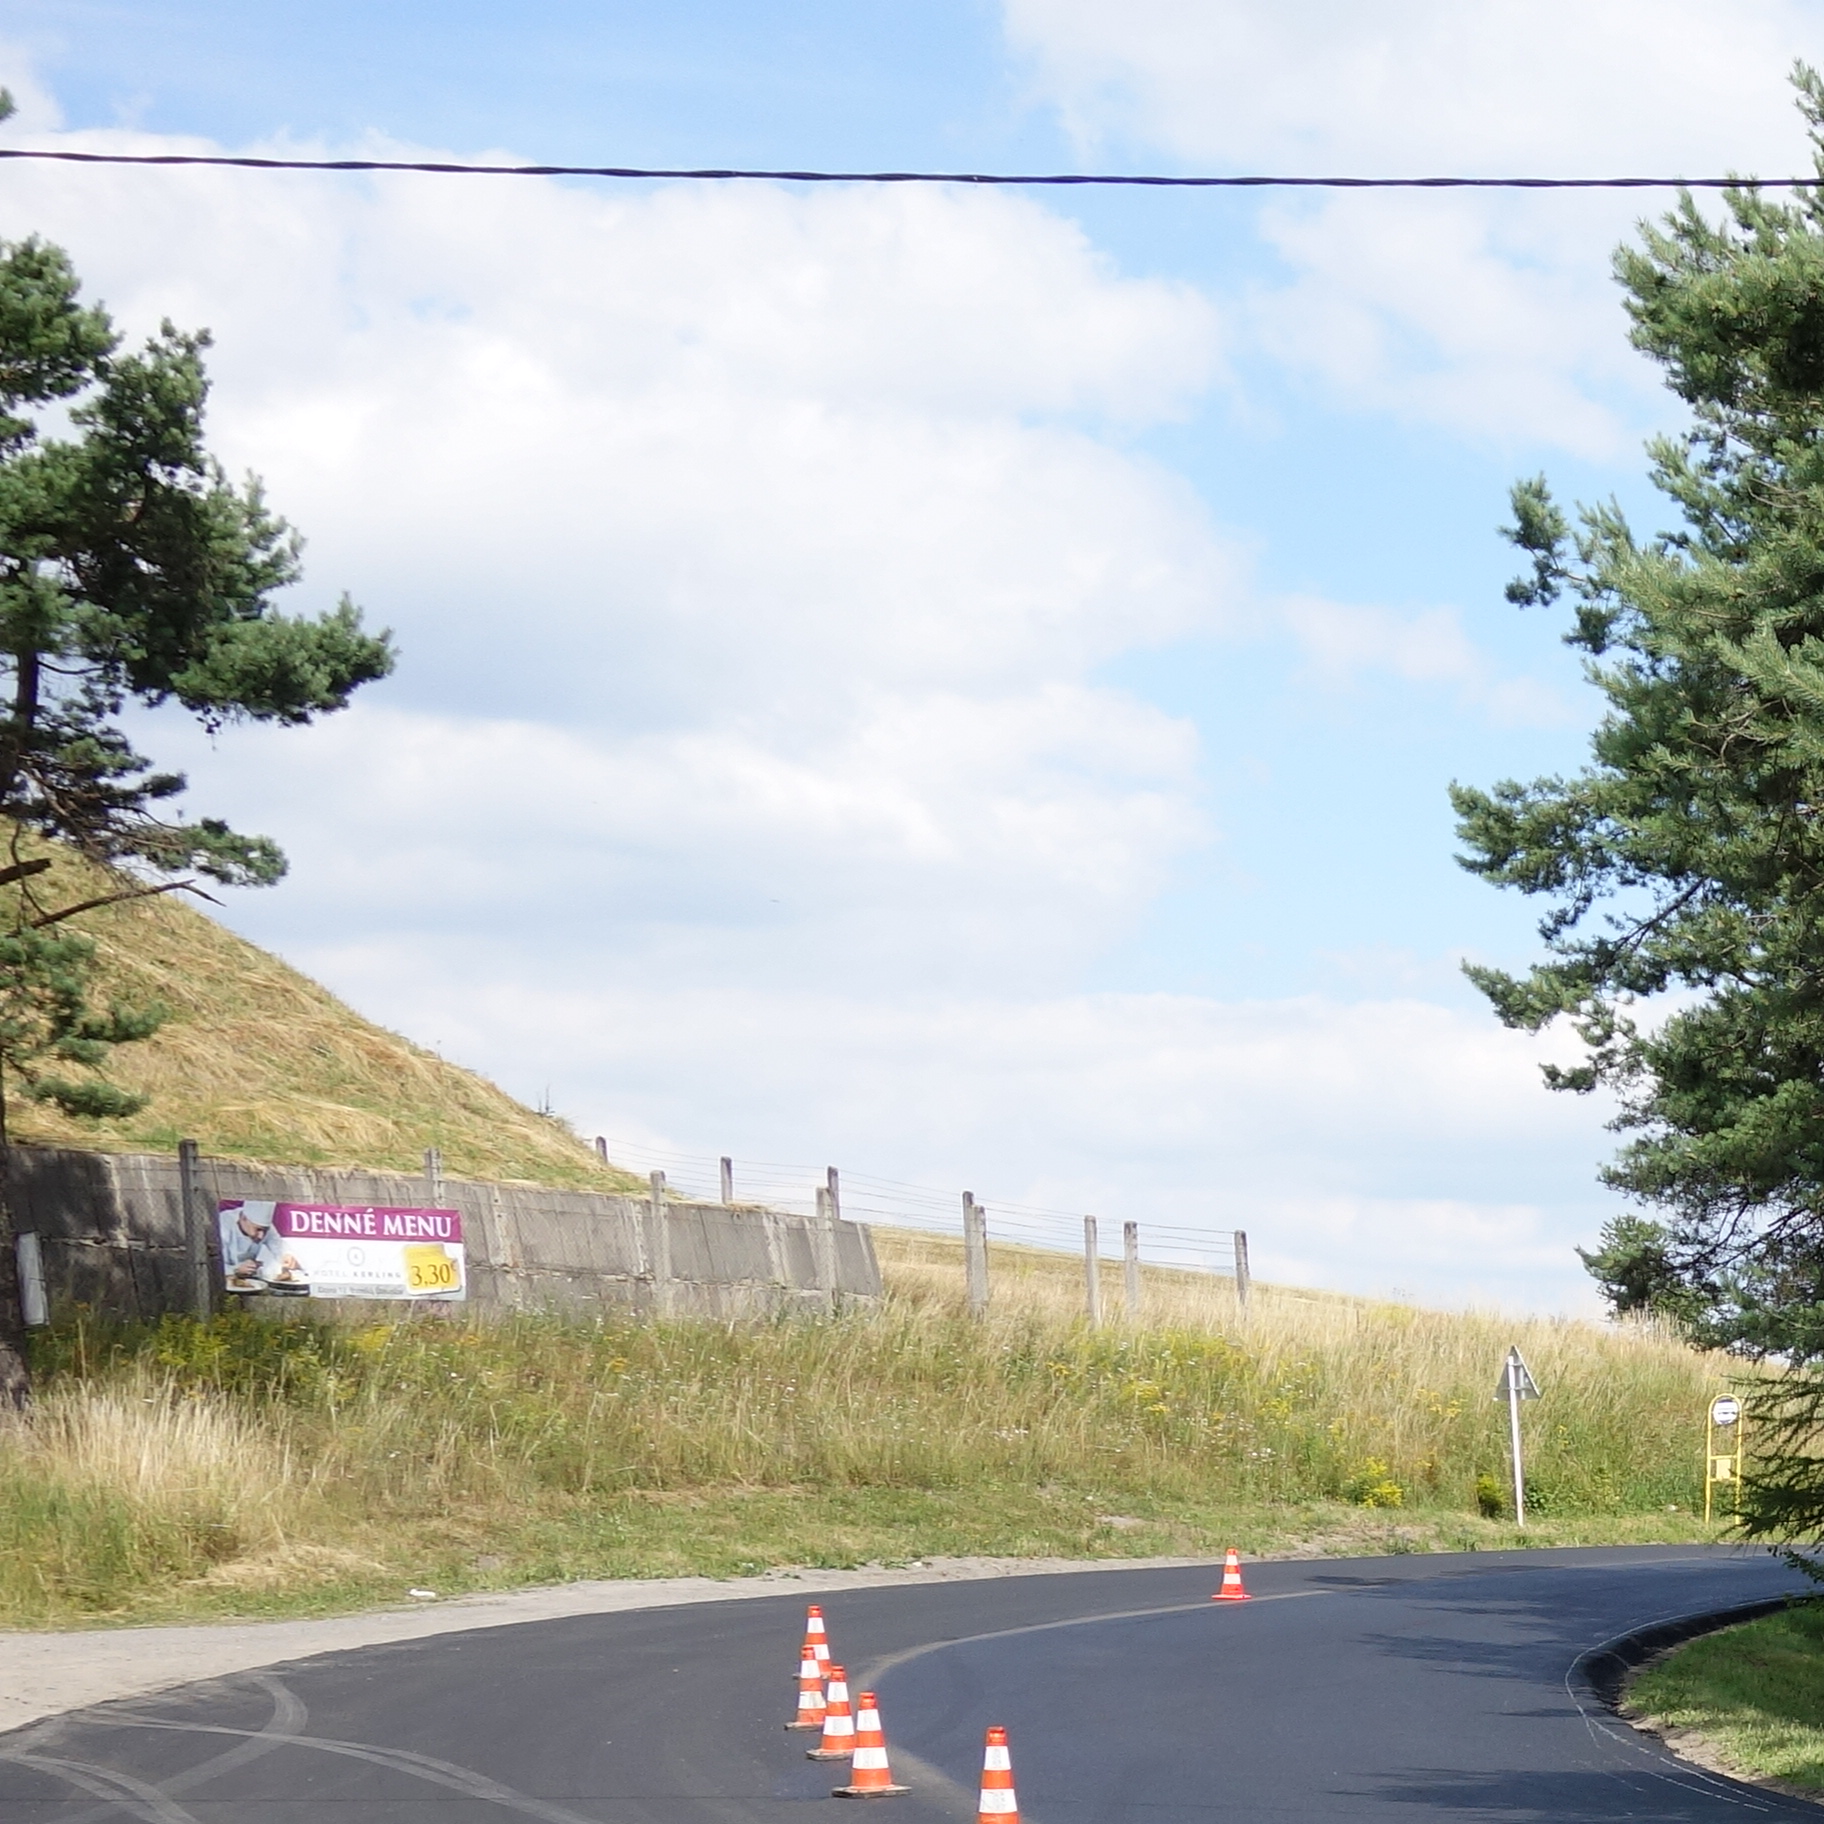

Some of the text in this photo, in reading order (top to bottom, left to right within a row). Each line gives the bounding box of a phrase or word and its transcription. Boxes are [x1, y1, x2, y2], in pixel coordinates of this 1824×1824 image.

[289, 1208, 452, 1238] DENNÉ MENU
[353, 1270, 402, 1279] KERLING
